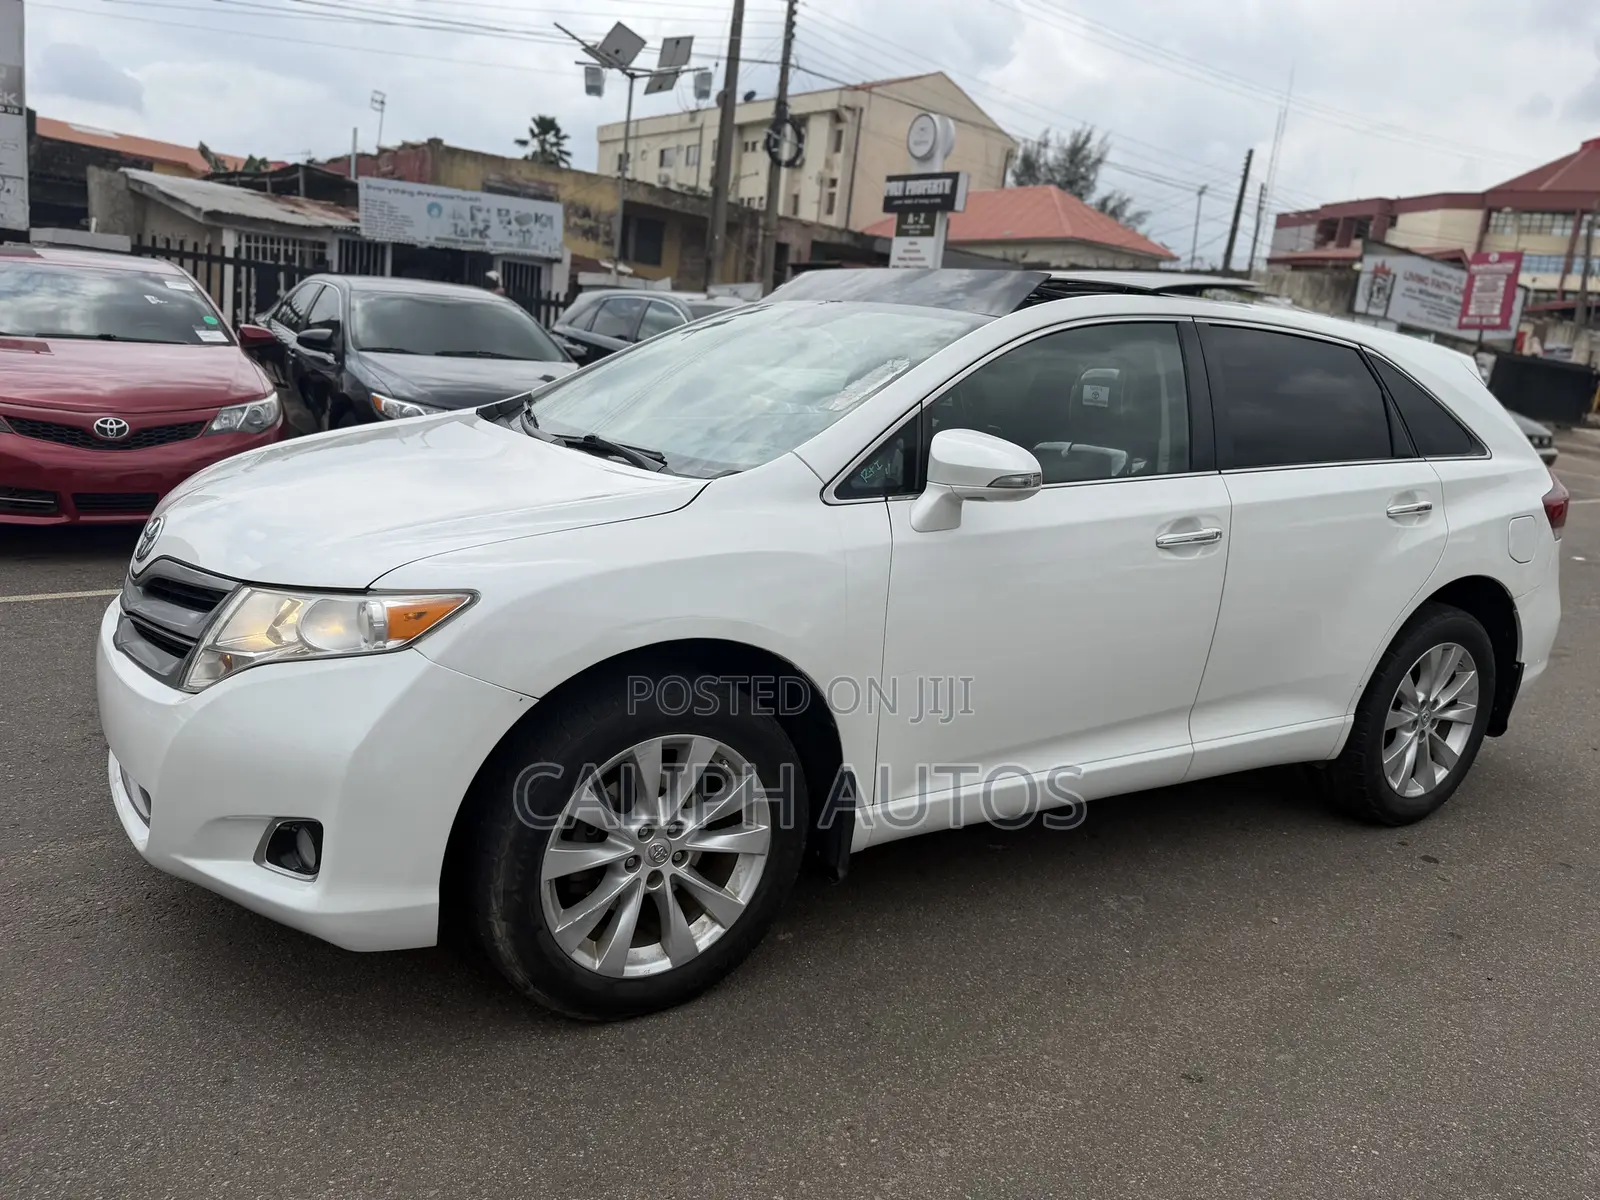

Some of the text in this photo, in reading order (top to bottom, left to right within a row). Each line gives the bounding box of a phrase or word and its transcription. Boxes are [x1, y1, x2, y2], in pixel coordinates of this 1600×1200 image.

[905, 178, 953, 196] PROPERTY
[1403, 270, 1429, 286] LIVING
[1431, 277, 1452, 292] FAITH
